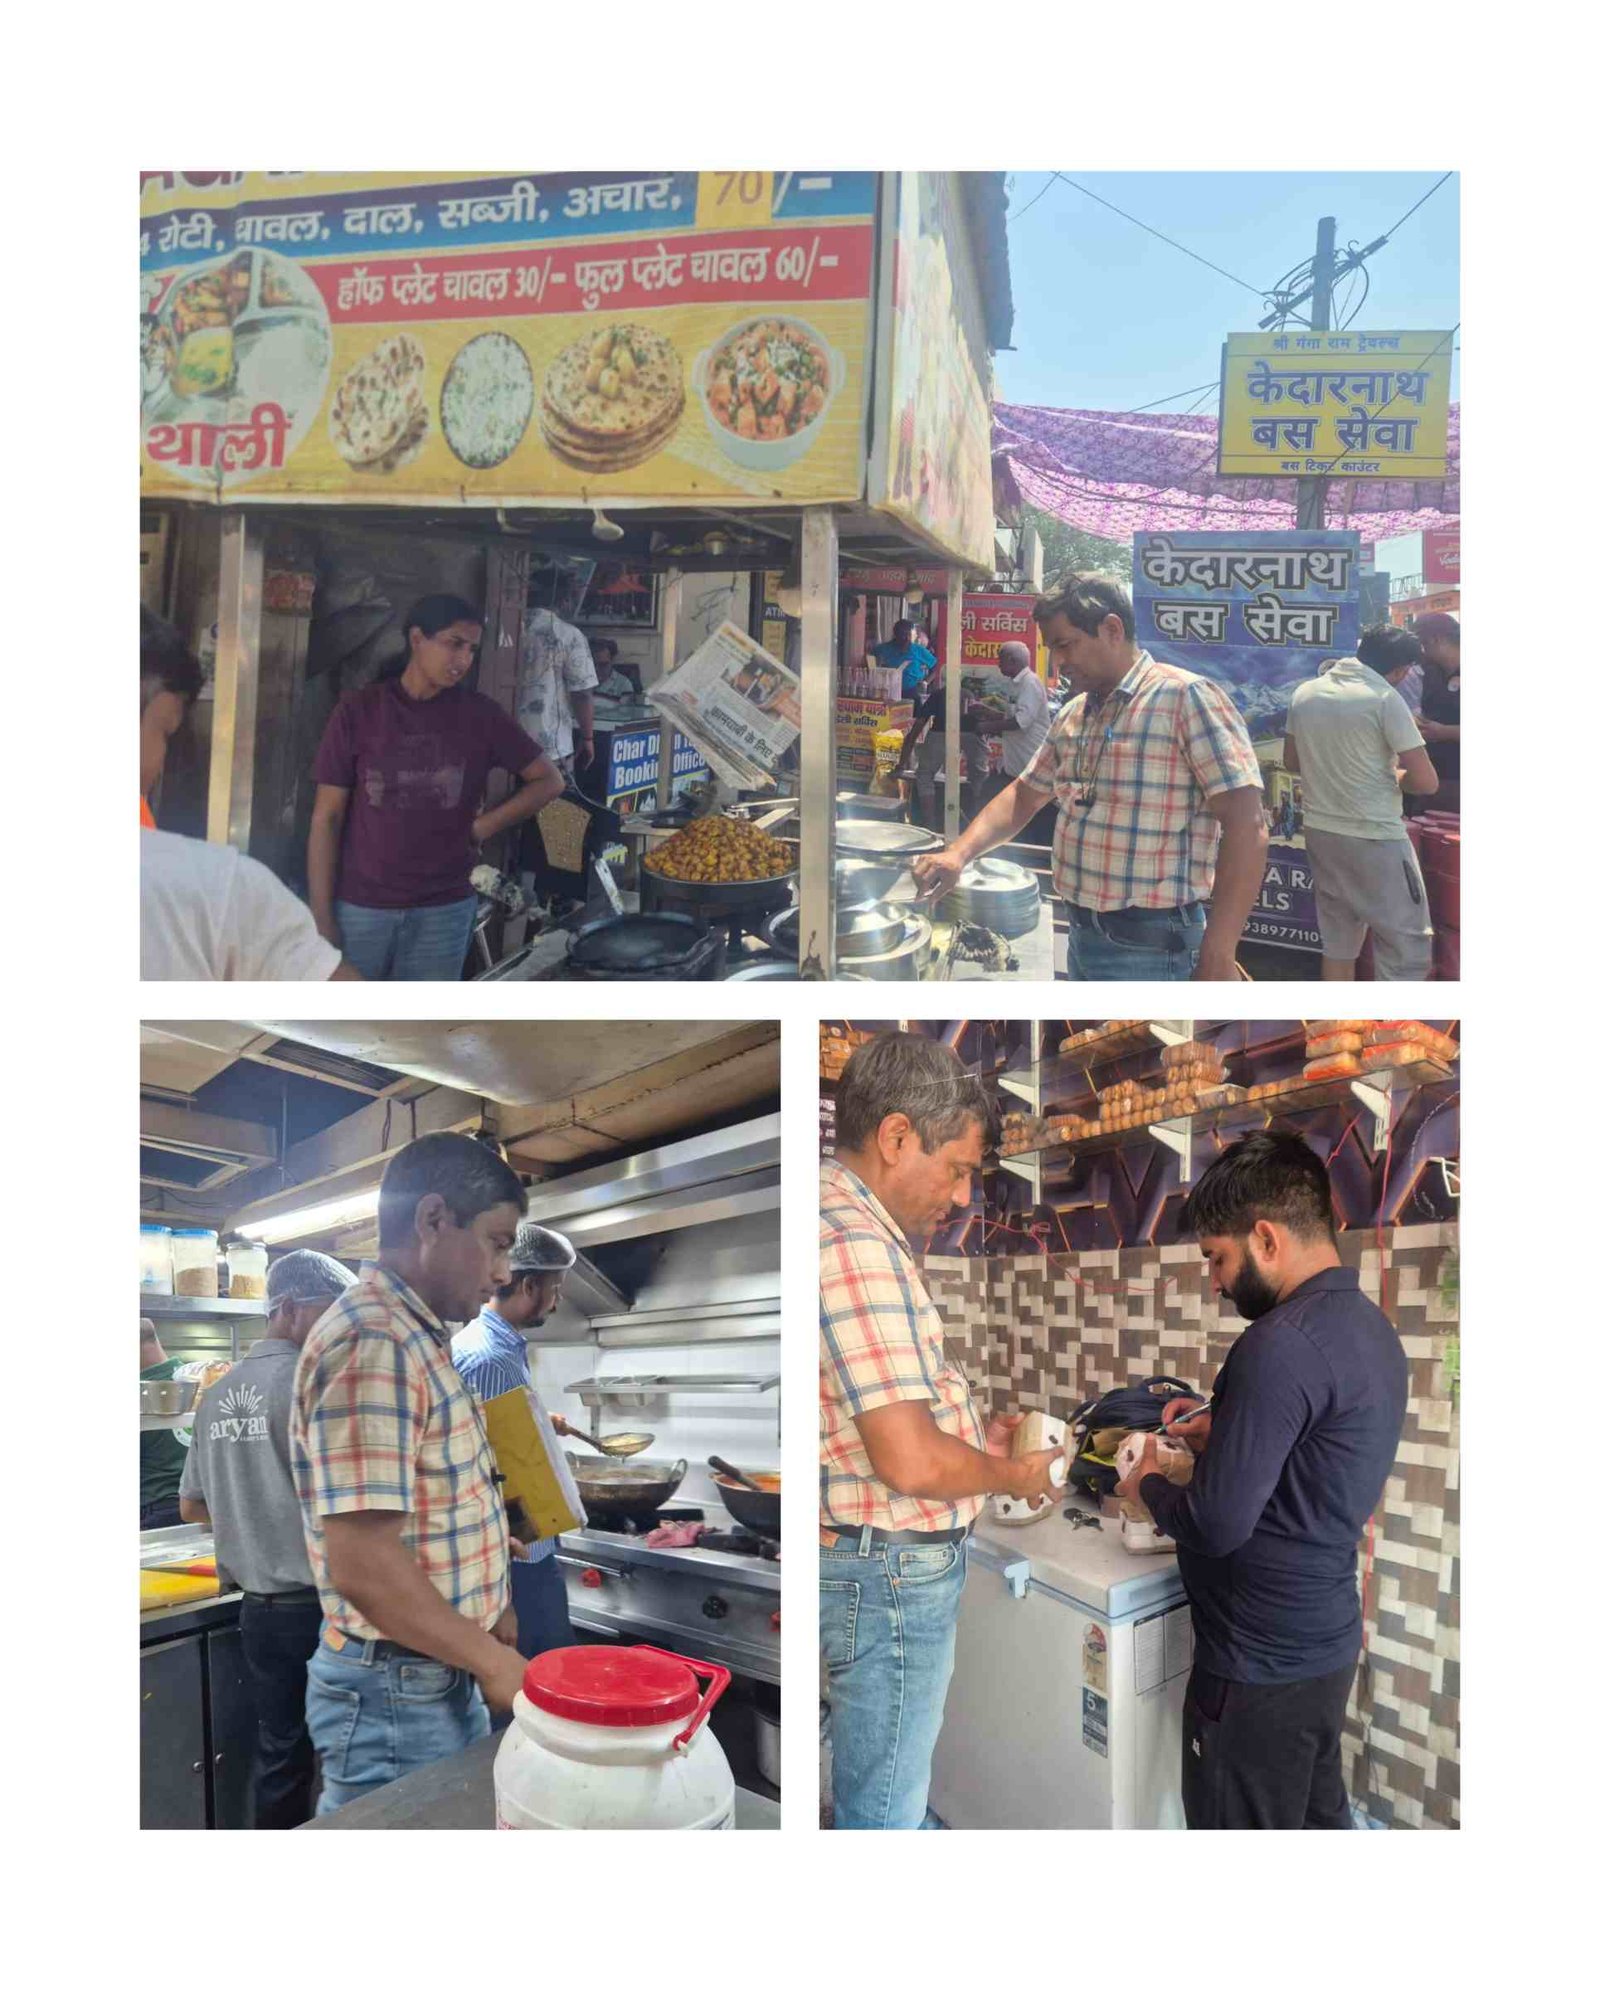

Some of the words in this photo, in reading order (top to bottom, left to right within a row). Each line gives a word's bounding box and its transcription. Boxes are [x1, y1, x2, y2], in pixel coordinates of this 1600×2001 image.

[344, 203, 424, 235] दाल,
[439, 180, 549, 228] सब्जी,
[562, 179, 682, 217] अचार,
[391, 262, 439, 305] प्लेट
[443, 267, 511, 302] चावल
[514, 256, 566, 302] 30/-
[574, 257, 628, 311] फुल
[631, 243, 685, 292] प्लेट
[690, 246, 771, 284] चावल
[775, 236, 838, 288] 60/-
[1247, 360, 1431, 406] केदारनाथ
[146, 401, 292, 473] थाली
[1251, 416, 1321, 451] बस
[1334, 405, 1421, 452] सेवा
[1280, 461, 1299, 471] बस
[1305, 459, 1335, 472] टिकट
[1341, 460, 1380, 472] काउंटर
[1142, 537, 1353, 589] केदारनाथ
[981, 611, 1029, 632] सर्विस
[1154, 603, 1229, 641] बस
[1243, 593, 1338, 645] सेवा
[613, 738, 646, 764] Char
[210, 1416, 269, 1443] aryan
